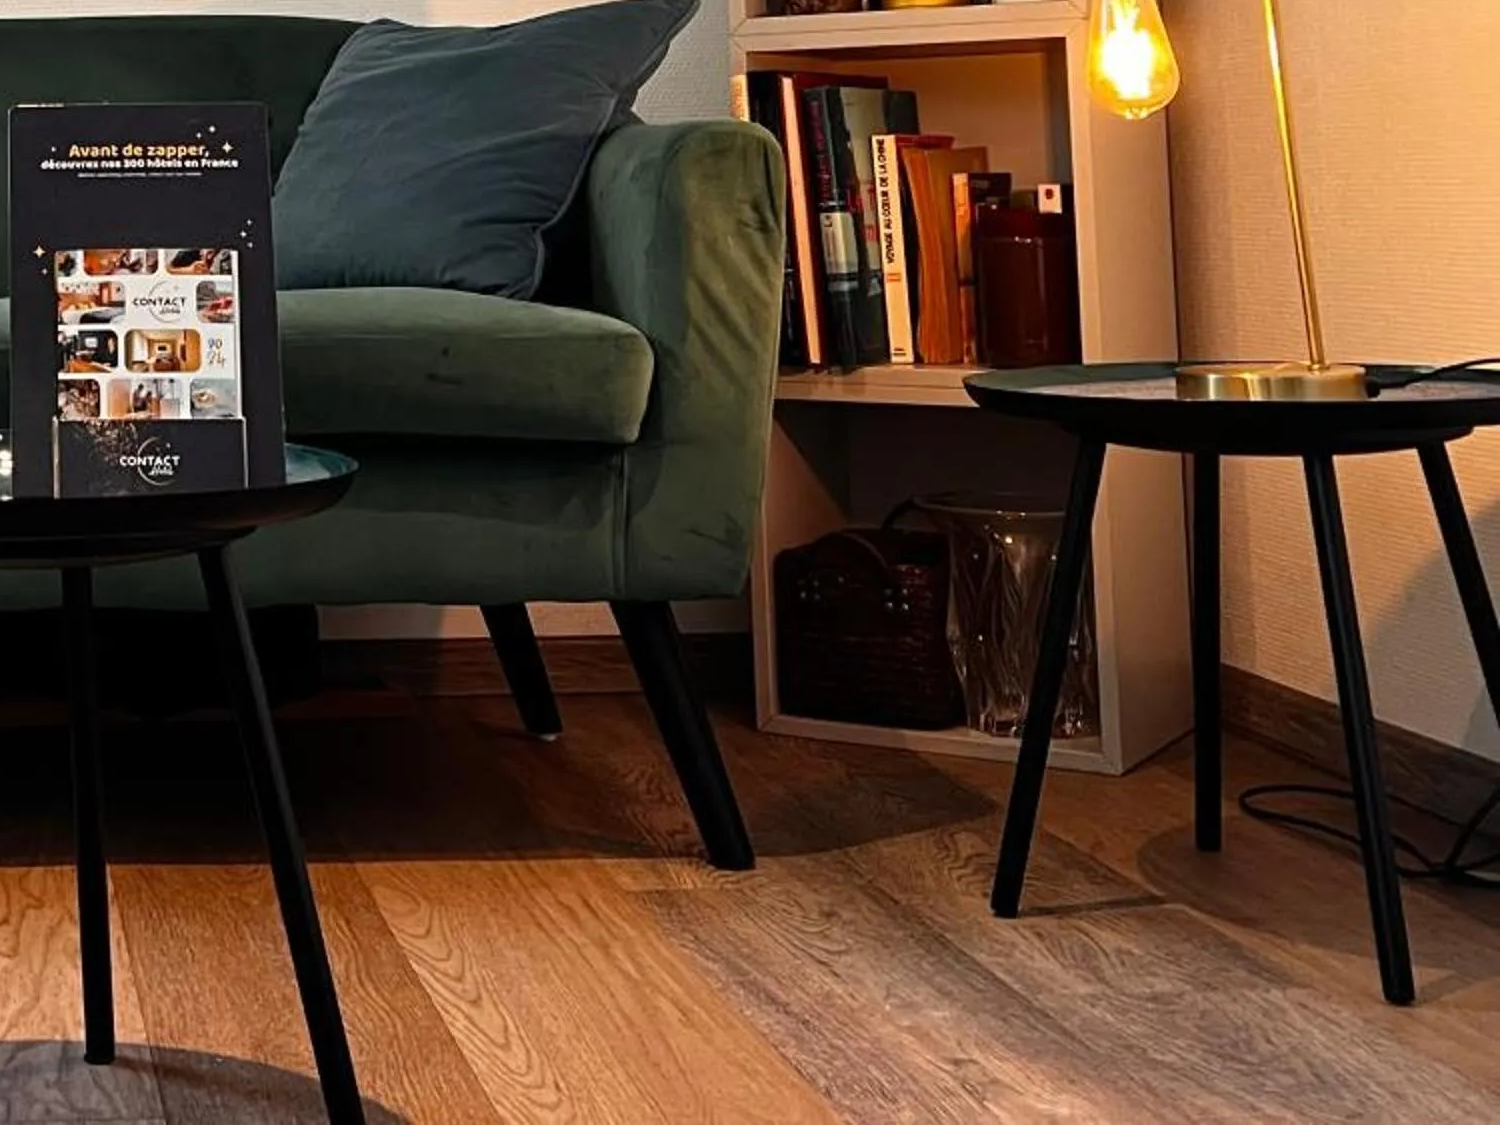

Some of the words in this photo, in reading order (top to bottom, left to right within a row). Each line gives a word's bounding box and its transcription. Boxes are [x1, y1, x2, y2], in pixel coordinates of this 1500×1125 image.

[69, 145, 119, 158] Avant
[122, 144, 143, 156] de
[147, 145, 209, 160] zapper,
[184, 160, 199, 168] en
[201, 159, 239, 168] France
[878, 163, 888, 175] LA
[879, 176, 889, 188] DE
[883, 218, 893, 230] AU
[884, 232, 895, 264] VOYAGE
[132, 296, 187, 306] CONTACT
[119, 455, 180, 466] CONTACT
